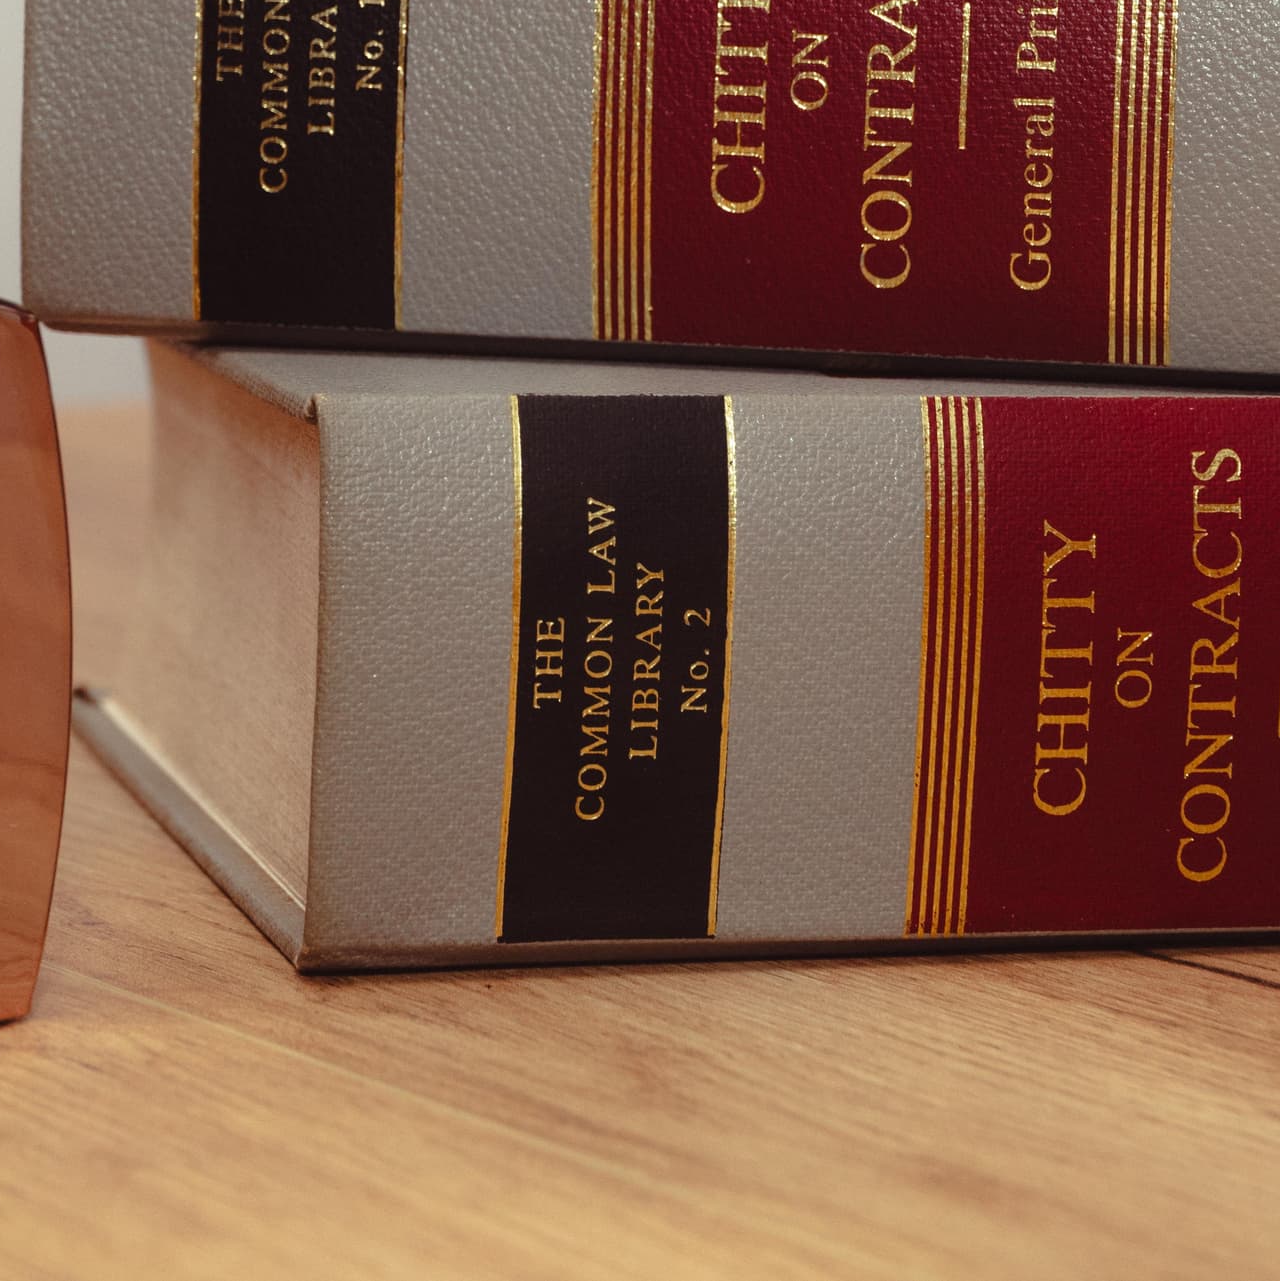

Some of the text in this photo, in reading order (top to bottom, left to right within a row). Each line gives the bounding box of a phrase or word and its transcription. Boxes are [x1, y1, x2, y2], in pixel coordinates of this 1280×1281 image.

[355, 28, 385, 92] No.
[790, 29, 830, 111] ON
[1010, 97, 1057, 291] General
[533, 617, 565, 710] THE
[575, 497, 616, 821] COMMON LAW
[629, 562, 664, 760] LIBRARY
[680, 607, 711, 713] No. 2
[1032, 519, 1097, 817] CHITTY
[1114, 627, 1154, 709] ON
[1176, 447, 1243, 883] CONTRACTS
